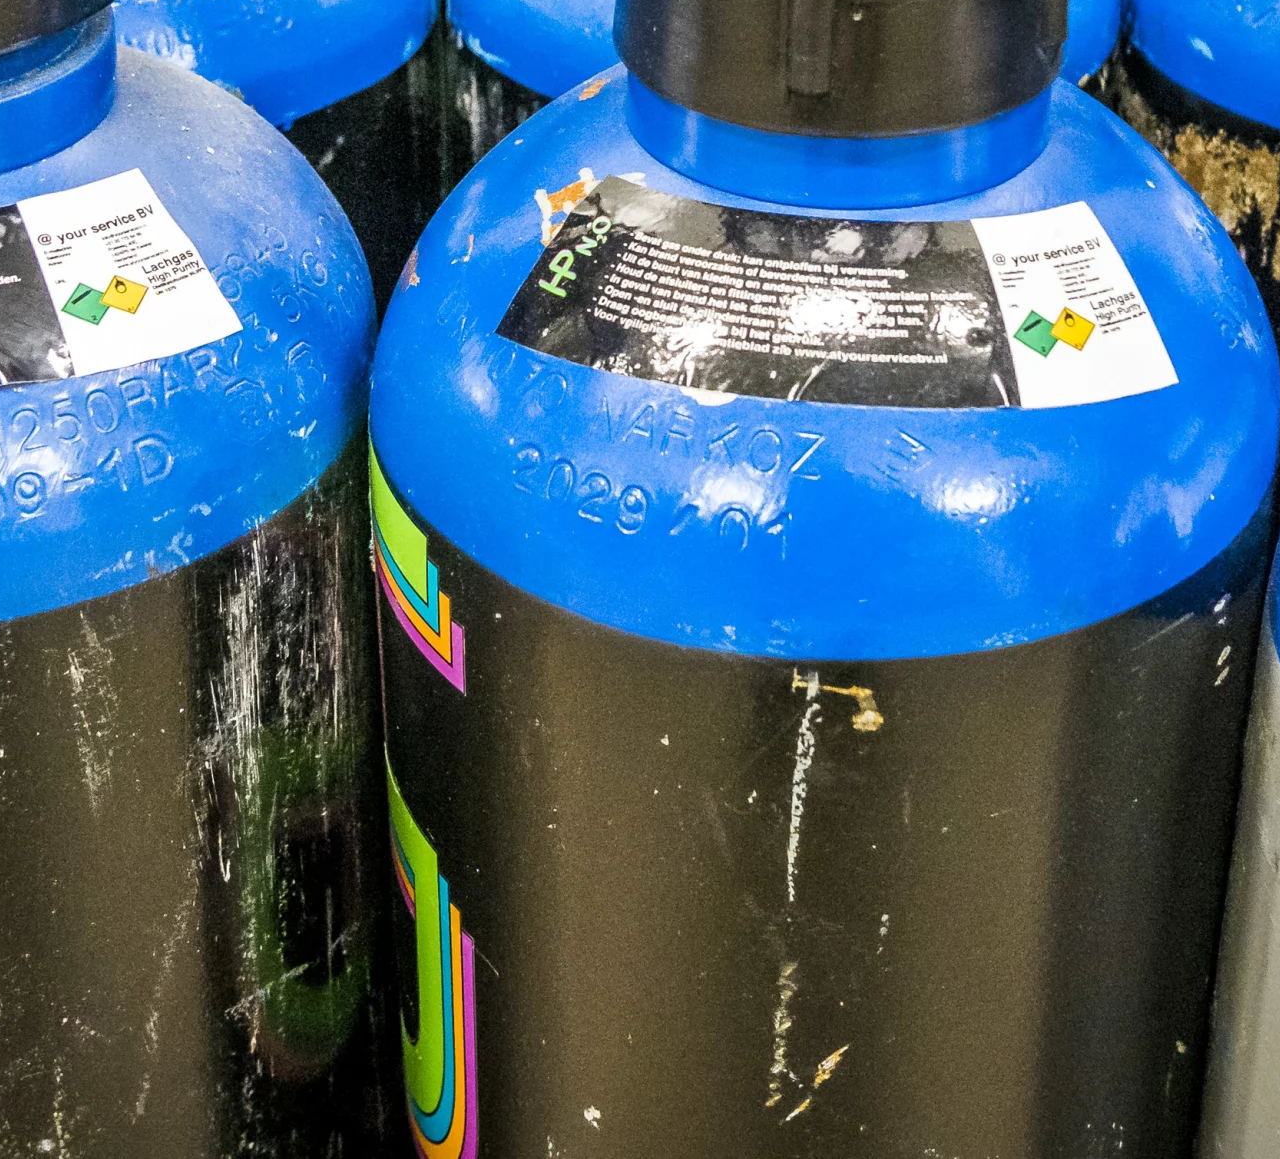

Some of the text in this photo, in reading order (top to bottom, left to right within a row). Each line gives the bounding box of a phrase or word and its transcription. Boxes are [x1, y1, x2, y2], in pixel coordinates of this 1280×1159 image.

[38, 204, 154, 246] @ your service BV
[142, 250, 194, 274] Lachgas
[634, 231, 908, 279] Bevat gas onder druk; kan ontploffen bij verwarming.
[992, 237, 1101, 267] @ your service BV
[148, 271, 171, 284] High
[172, 260, 200, 278] Purity
[628, 242, 891, 288] Kan brand veroorzaken of bevorderen; oxiderend.
[1090, 291, 1136, 310] Lachgas
[1095, 302, 1141, 322] High Purity
[772, 345, 792, 355] zie
